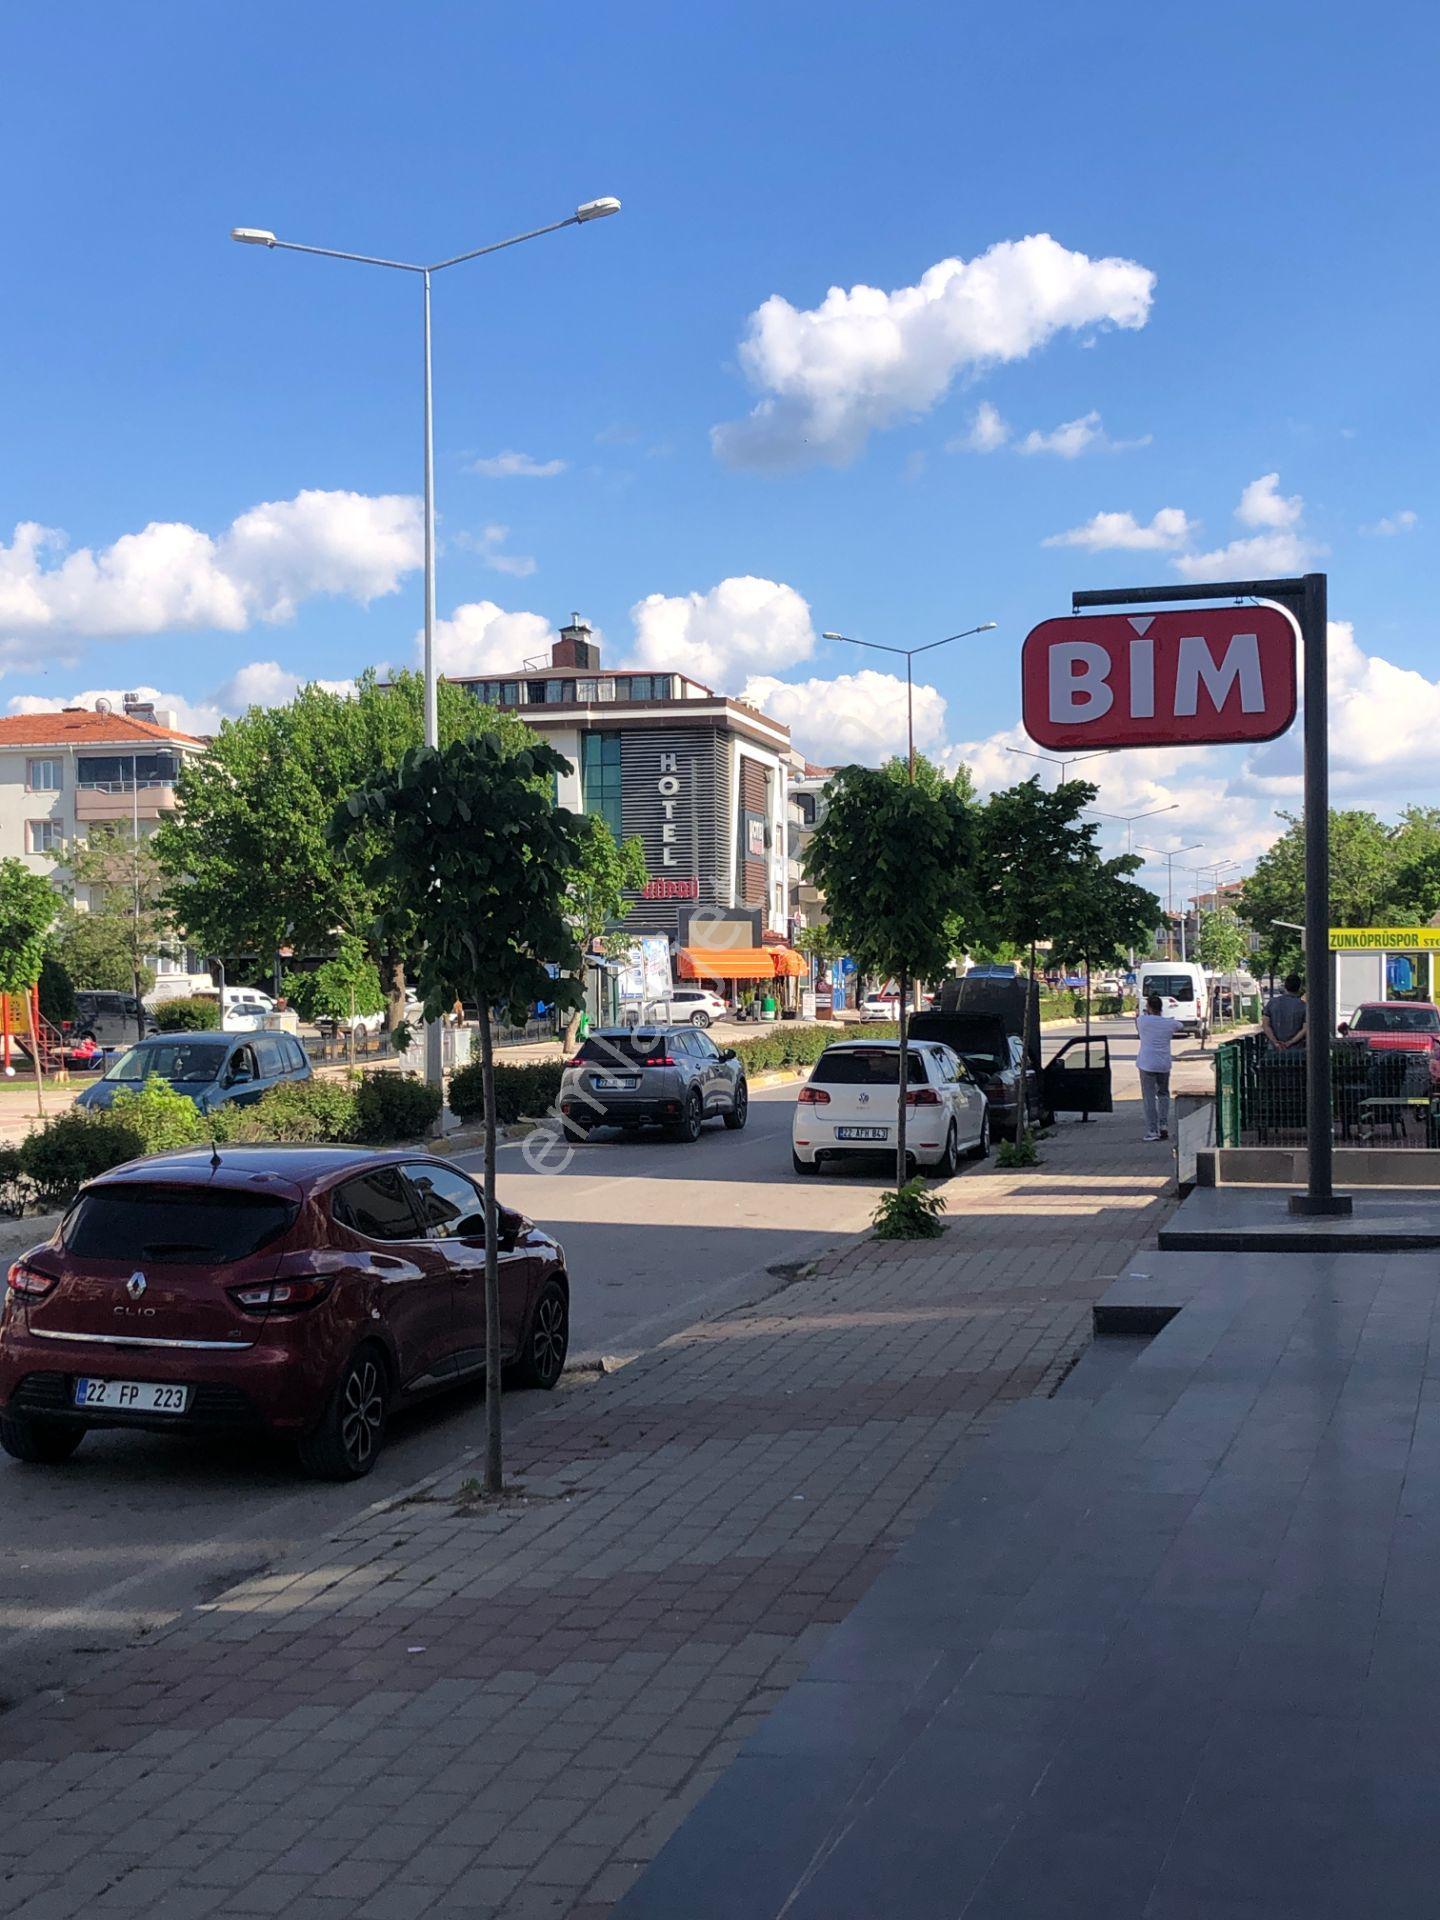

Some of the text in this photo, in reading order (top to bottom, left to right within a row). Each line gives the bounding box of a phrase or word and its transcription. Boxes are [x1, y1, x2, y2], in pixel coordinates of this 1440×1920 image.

[1049, 616, 1265, 724] BİM
[658, 752, 679, 866] HOTEL
[1329, 931, 1418, 947] ZUNKÖPRÜSPOR
[113, 1306, 156, 1317] CLIO
[86, 1383, 184, 1409] 22 FP 223
